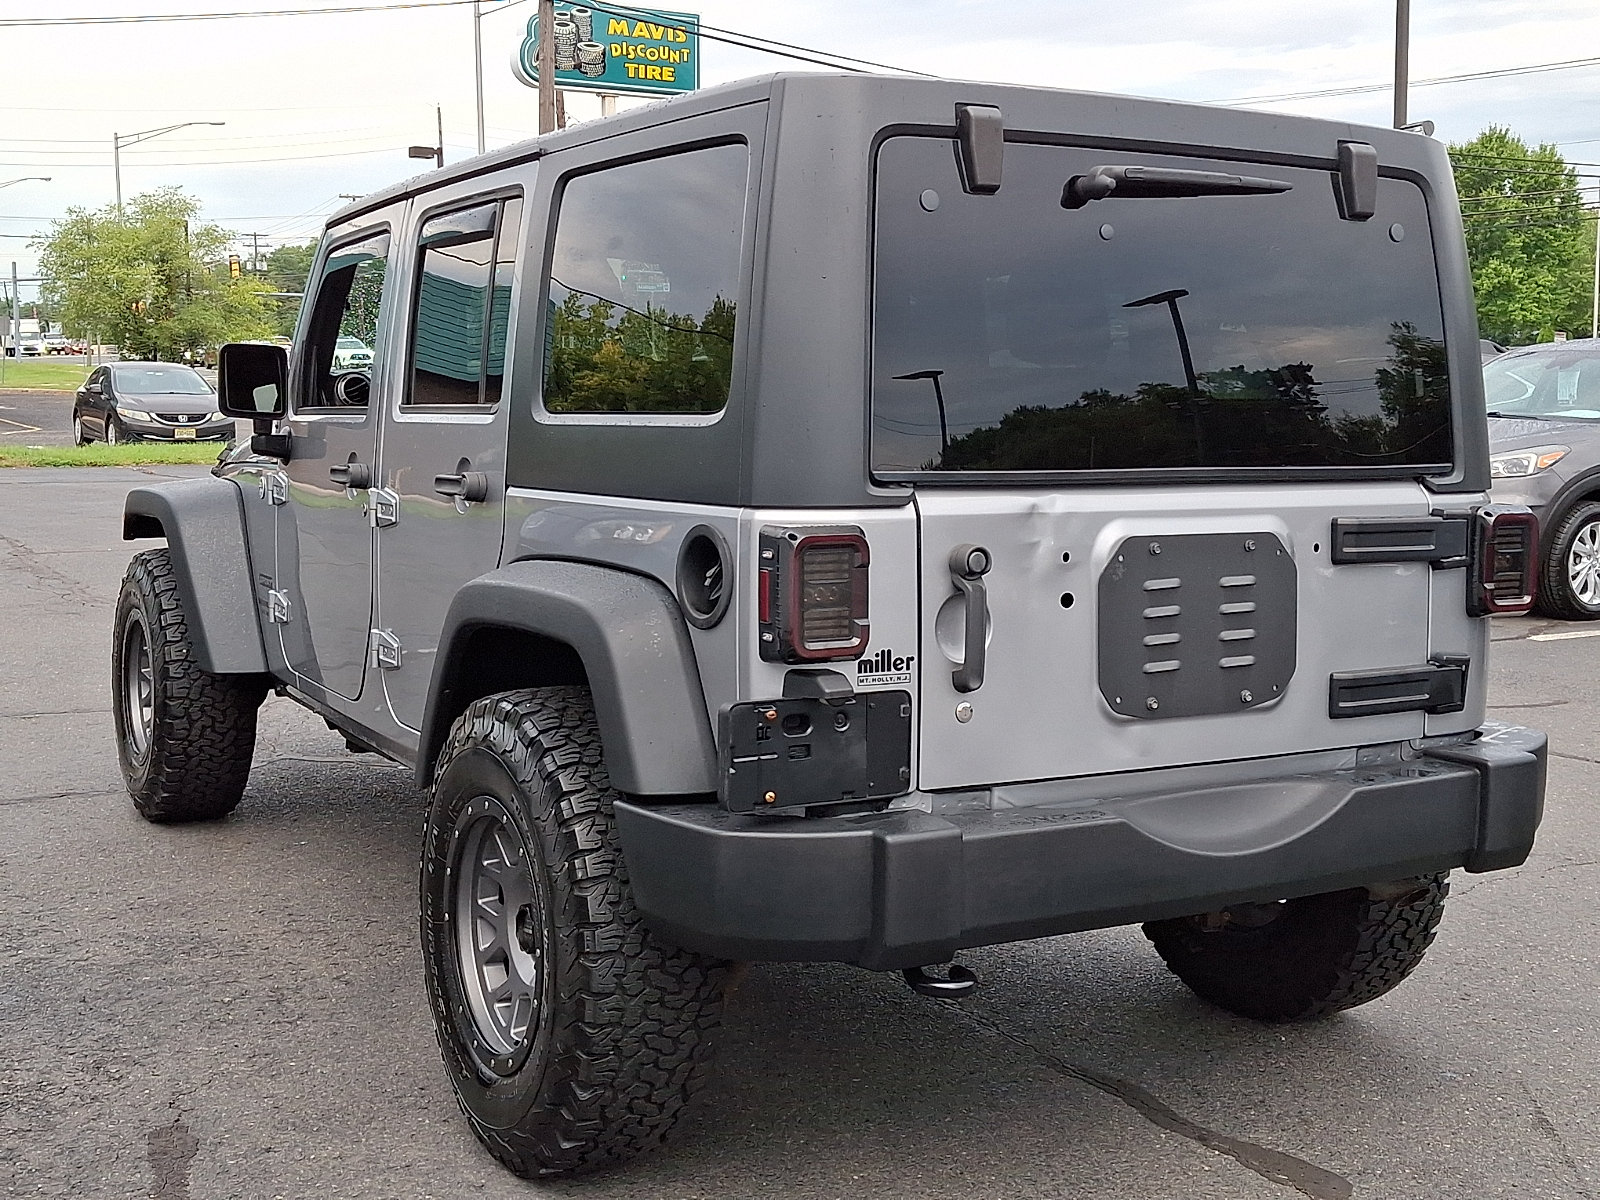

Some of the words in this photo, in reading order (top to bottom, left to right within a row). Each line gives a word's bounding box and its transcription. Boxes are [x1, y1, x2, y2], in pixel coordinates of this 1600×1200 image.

[607, 18, 687, 43] MAVIS
[609, 41, 690, 63] DISCOUNT
[624, 62, 676, 82] TIRE
[857, 649, 915, 674] miller
